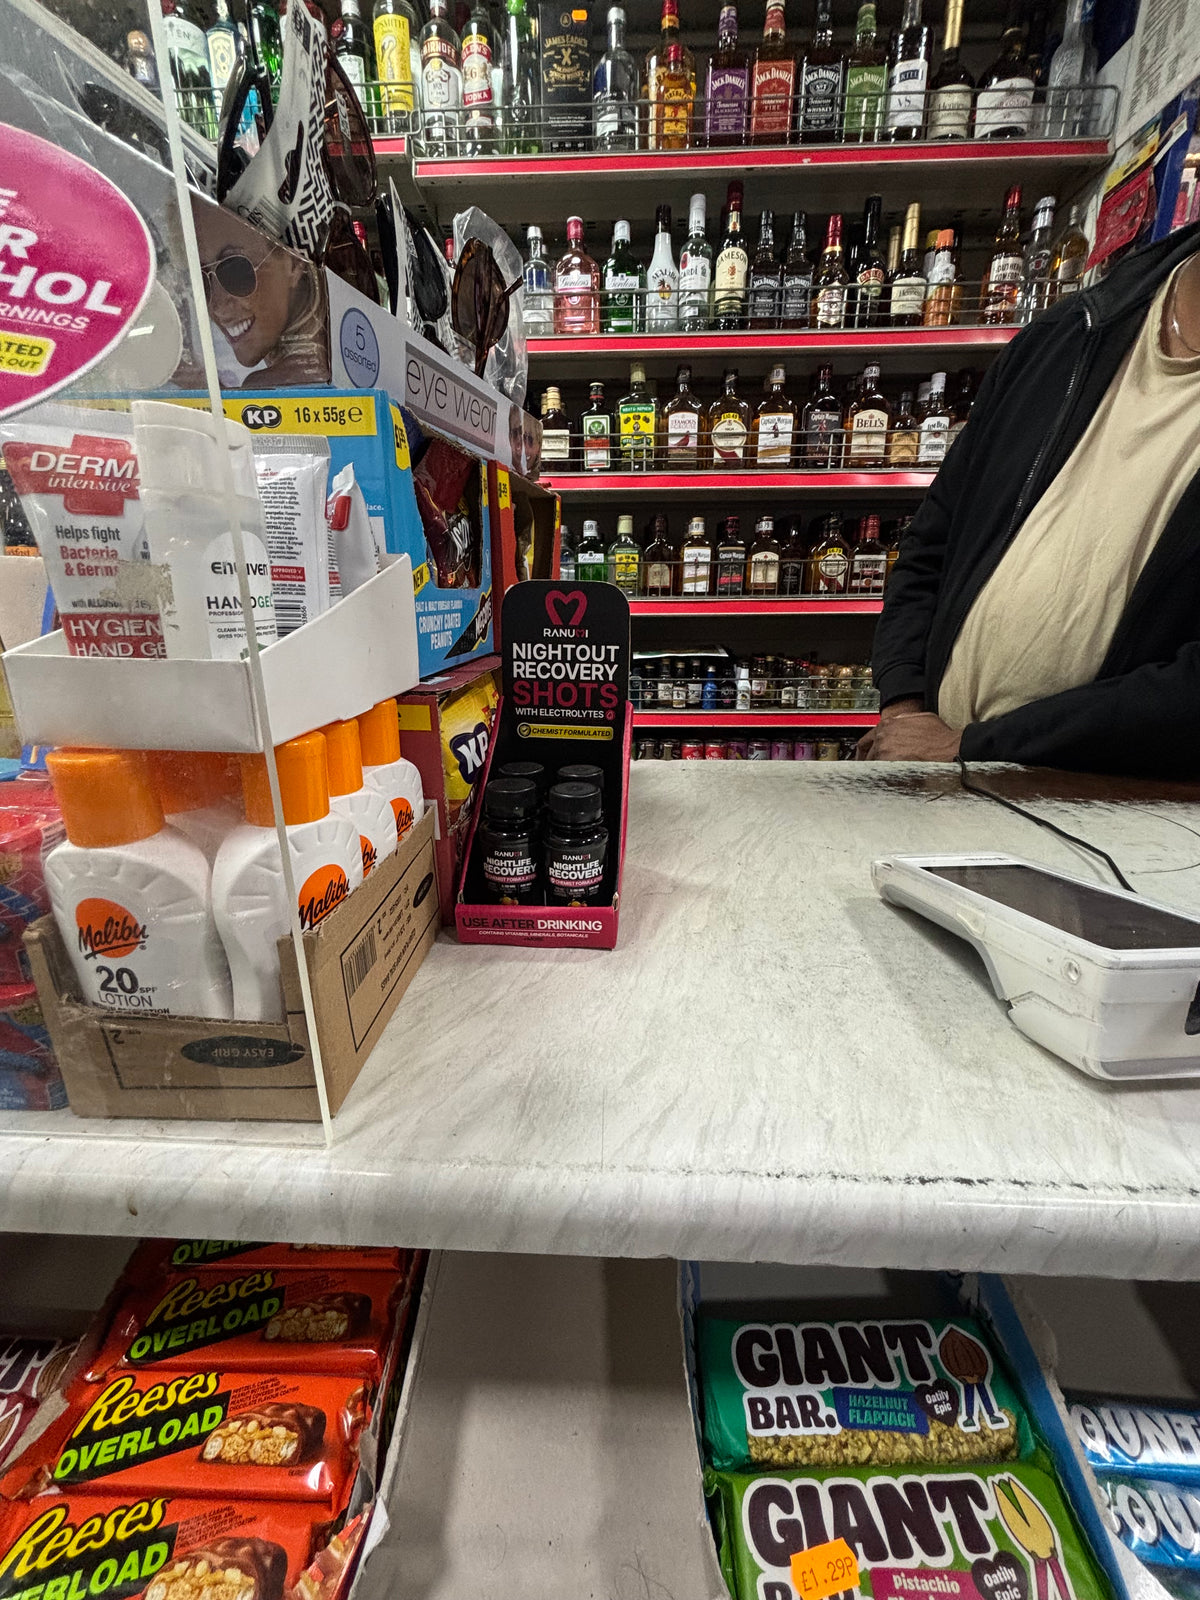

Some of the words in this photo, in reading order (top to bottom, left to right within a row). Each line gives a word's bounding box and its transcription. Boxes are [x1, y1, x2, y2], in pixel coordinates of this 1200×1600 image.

[711, 78, 725, 91] JACK
[757, 71, 771, 86] JACK
[804, 71, 818, 85] JACK
[717, 251, 747, 268] JAMESON
[560, 279, 589, 288] Gordon's
[607, 279, 637, 288] Gordon's
[354, 325, 366, 350] 5
[0, 340, 44, 358] TED
[344, 347, 378, 374] assorted
[406, 358, 449, 409] eye
[453, 383, 497, 437] wear
[246, 410, 279, 425] KP
[294, 407, 311, 423] 16
[314, 412, 321, 422] x
[856, 418, 884, 428] BELL'S
[30, 451, 140, 480] DERM
[48, 474, 131, 493] intensive
[55, 526, 89, 542] Helps
[92, 525, 121, 543] fight
[60, 546, 118, 560] Bacteria
[65, 565, 75, 576] &
[75, 642, 134, 658] HAND
[512, 643, 620, 662] NIGHTOUT
[512, 662, 619, 681] RECOVERY
[513, 681, 618, 708] SHOTS
[515, 707, 538, 716] WITH
[539, 708, 605, 719] ELECTROLYTES
[531, 727, 563, 736] CHEMIST
[563, 728, 611, 737] FORMULATED
[457, 730, 490, 775] KP
[484, 862, 537, 876] RECOVERY
[486, 857, 532, 867] NIGHTLIFE
[553, 860, 600, 871] NIGHTLIFE
[549, 865, 603, 880] RECOVERY
[299, 874, 350, 930] Malibu
[462, 917, 489, 928] USE
[492, 918, 535, 929] AFTER
[537, 920, 603, 931] DRINKING
[78, 915, 149, 955] Malibu
[96, 965, 139, 994] 20
[98, 991, 153, 1007] LOTION
[211, 1047, 241, 1057] GRIP
[243, 1047, 274, 1058] EASY
[146, 1271, 273, 1328] Reese's
[129, 1297, 280, 1360] OVERLOAD
[735, 1324, 933, 1387] GIANT
[71, 1371, 219, 1438] Reese's
[849, 1393, 909, 1410] HAZELNUT
[925, 1389, 950, 1406] Oatily
[747, 1395, 837, 1430] BAR.
[934, 1400, 952, 1416] Epic
[848, 1408, 917, 1429] FLAPJACK
[53, 1404, 225, 1479] OVERLOAD
[749, 1478, 992, 1567] GIANT
[801, 1556, 855, 1592] £1.29P
[984, 1566, 1017, 1588] Oatily
[893, 1574, 961, 1594] Pistachio
